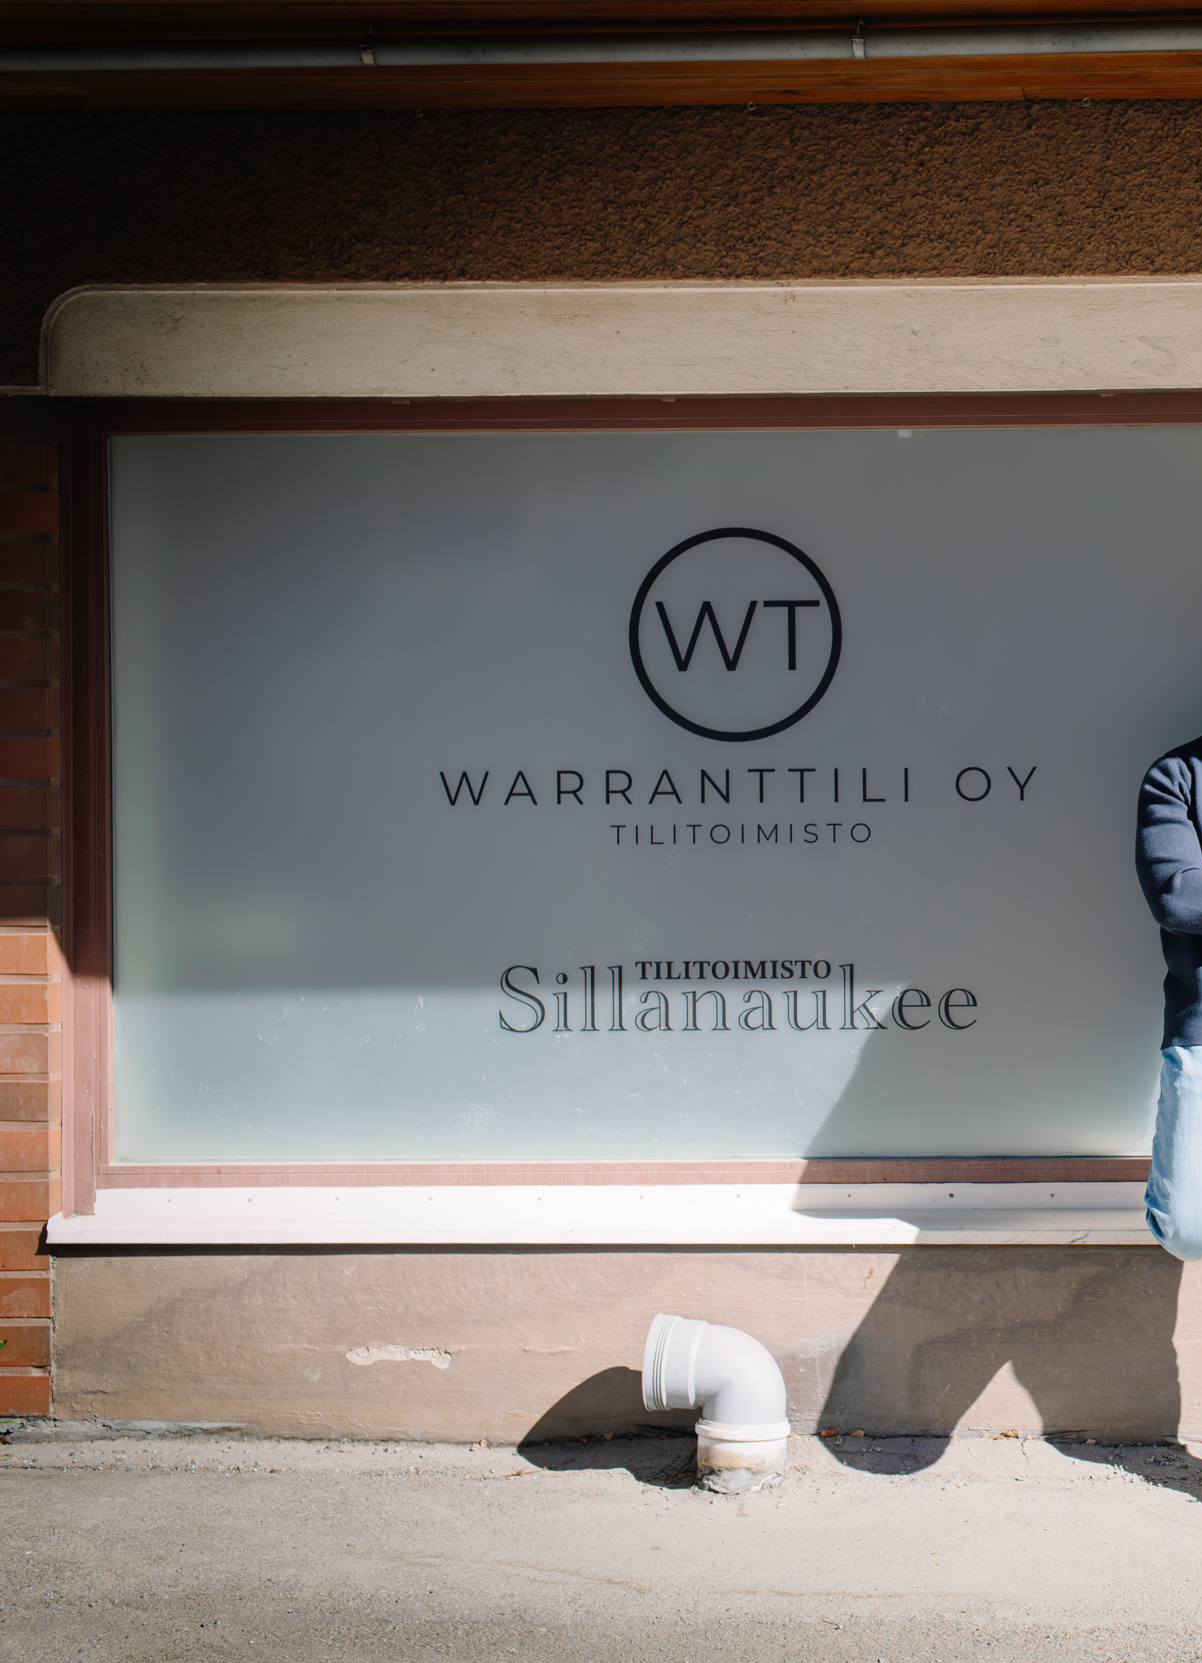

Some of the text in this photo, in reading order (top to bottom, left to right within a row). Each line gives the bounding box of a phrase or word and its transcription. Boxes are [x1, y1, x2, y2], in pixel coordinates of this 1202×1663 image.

[655, 600, 820, 672] WT
[439, 766, 1038, 806] WARRANTTILI OY
[610, 823, 872, 845] TILITOIMISTO
[635, 960, 832, 980] TILITOIMISTO
[498, 963, 978, 1034] Sillanaukee
